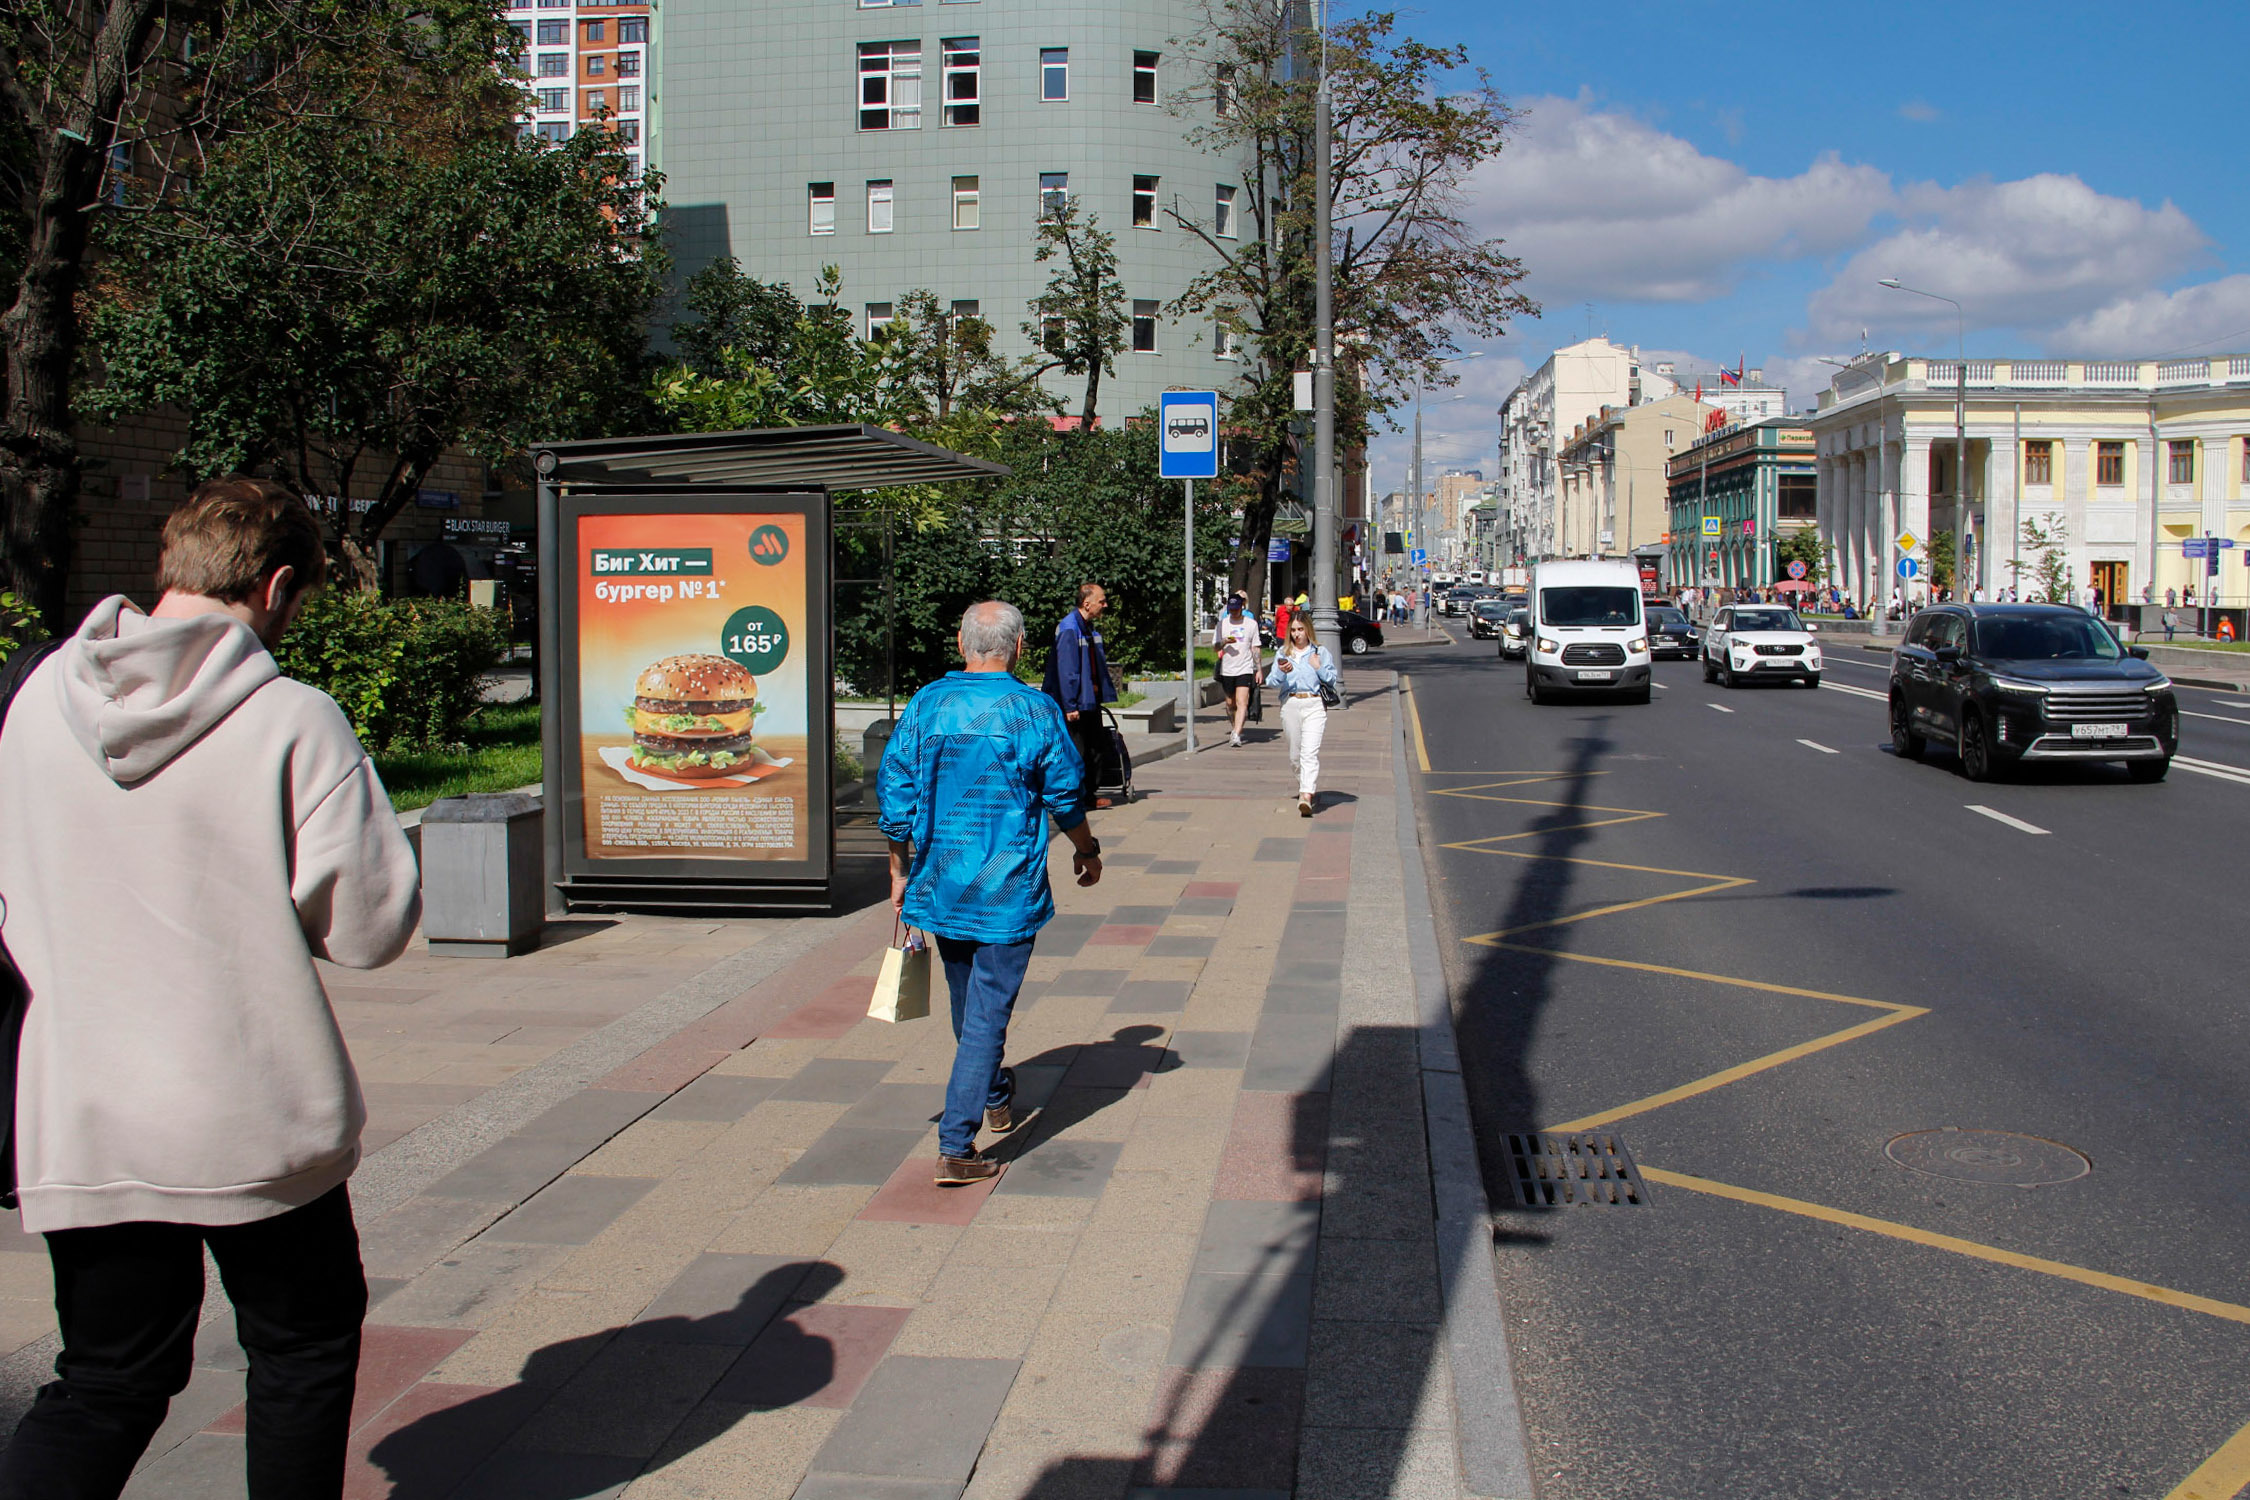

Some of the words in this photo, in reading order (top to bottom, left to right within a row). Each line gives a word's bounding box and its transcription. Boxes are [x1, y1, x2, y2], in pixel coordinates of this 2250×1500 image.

[451, 519, 471, 532] BLACK
[471, 520, 485, 533] STAR
[486, 520, 511, 534] BURGER
[595, 553, 634, 571] Биг
[638, 553, 680, 571] Хит
[595, 581, 673, 603] бургер
[747, 621, 763, 632] от
